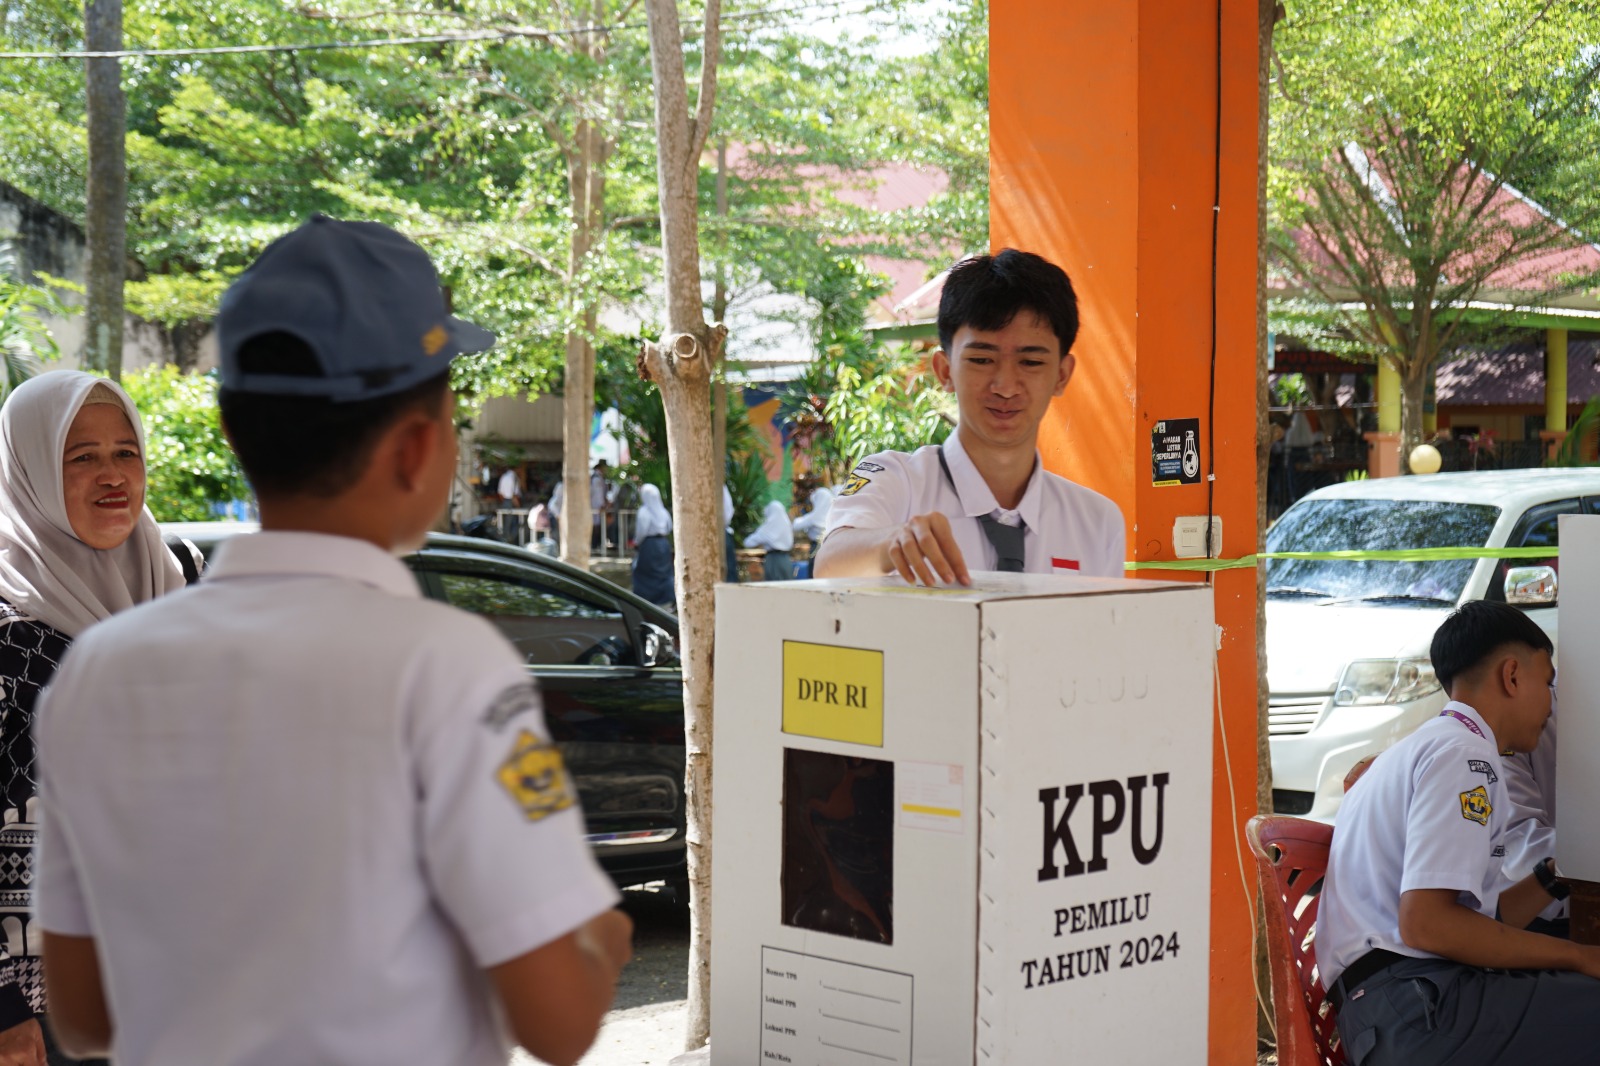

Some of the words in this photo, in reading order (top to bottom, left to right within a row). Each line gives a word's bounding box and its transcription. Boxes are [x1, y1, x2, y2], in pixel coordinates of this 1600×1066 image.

[798, 677, 839, 705] DPR
[845, 683, 868, 709] RI
[1037, 771, 1170, 883] KPU
[1054, 892, 1151, 937] PEMILU
[1021, 944, 1111, 990] TAHUN
[1119, 931, 1180, 969] 2024
